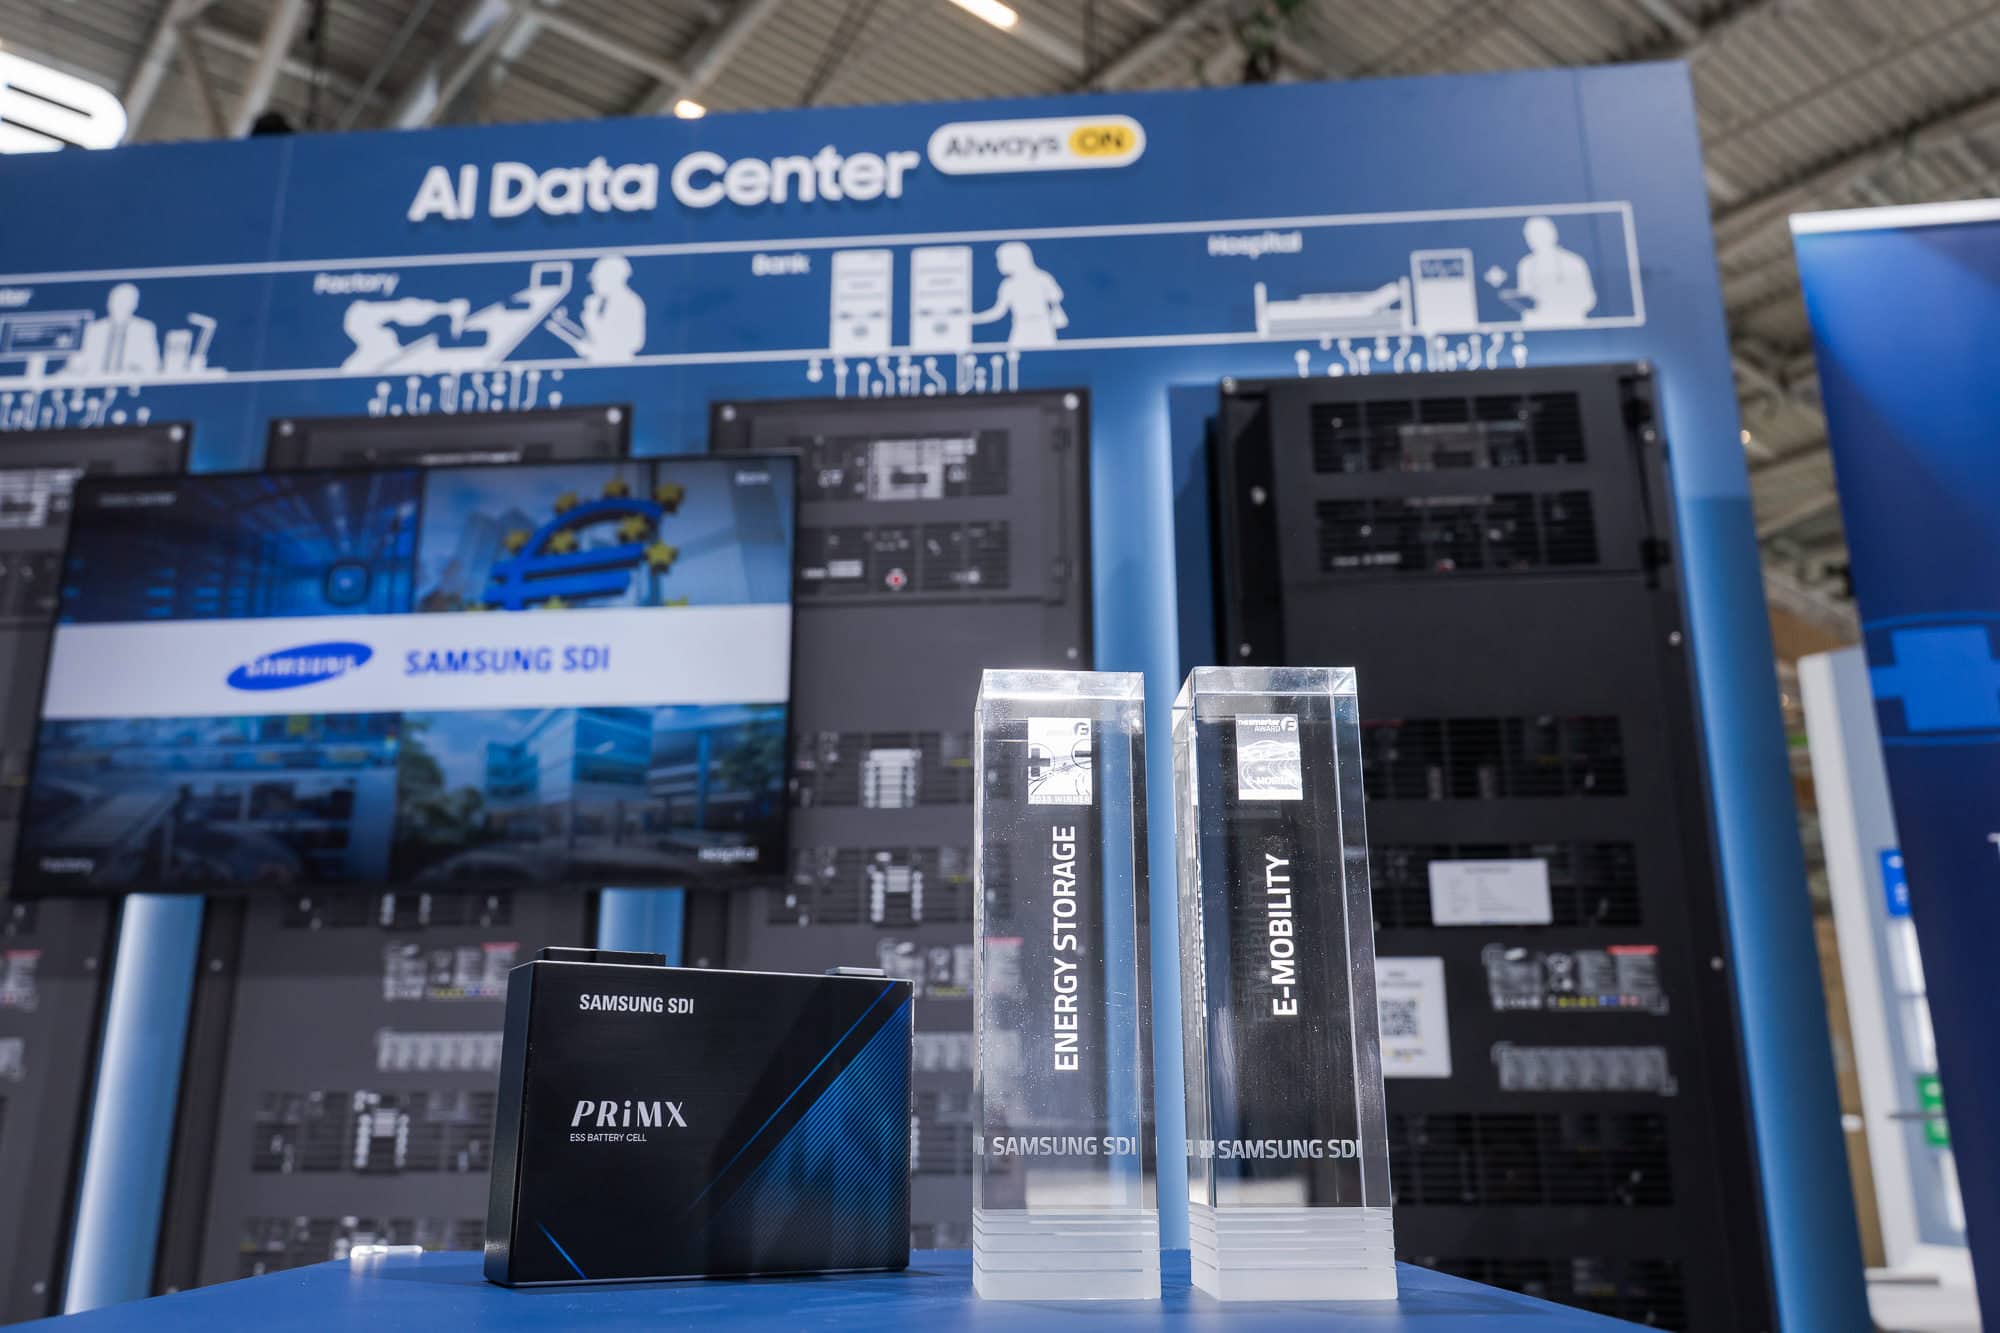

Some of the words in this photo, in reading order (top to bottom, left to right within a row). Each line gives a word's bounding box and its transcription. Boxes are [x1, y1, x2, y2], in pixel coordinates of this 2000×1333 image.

[944, 135, 1060, 160] Always
[1076, 128, 1124, 154] ON
[408, 165, 478, 221] AI
[489, 155, 658, 217] Data
[672, 146, 920, 207] Center
[1207, 231, 1302, 260] Hospital
[752, 254, 810, 276] Bank
[313, 272, 399, 297] Factory
[404, 647, 551, 676] SAMSUNG
[563, 644, 611, 672] SDI
[1052, 826, 1077, 951] STORAGE
[1265, 853, 1298, 1016] E-MOBILITY
[579, 994, 664, 1013] SAMSUNG
[667, 997, 695, 1014] SDI
[1053, 957, 1079, 1071] ENERGY
[571, 1100, 688, 1127] PRiMX
[570, 1133, 586, 1142] ESS
[587, 1133, 624, 1142] BATTERY
[626, 1133, 648, 1142] CELL
[992, 1136, 1098, 1156] SAMSUNG
[1102, 1136, 1137, 1156] SDI
[1218, 1139, 1323, 1159] SAMSUNG
[1327, 1139, 1362, 1158] SDI
